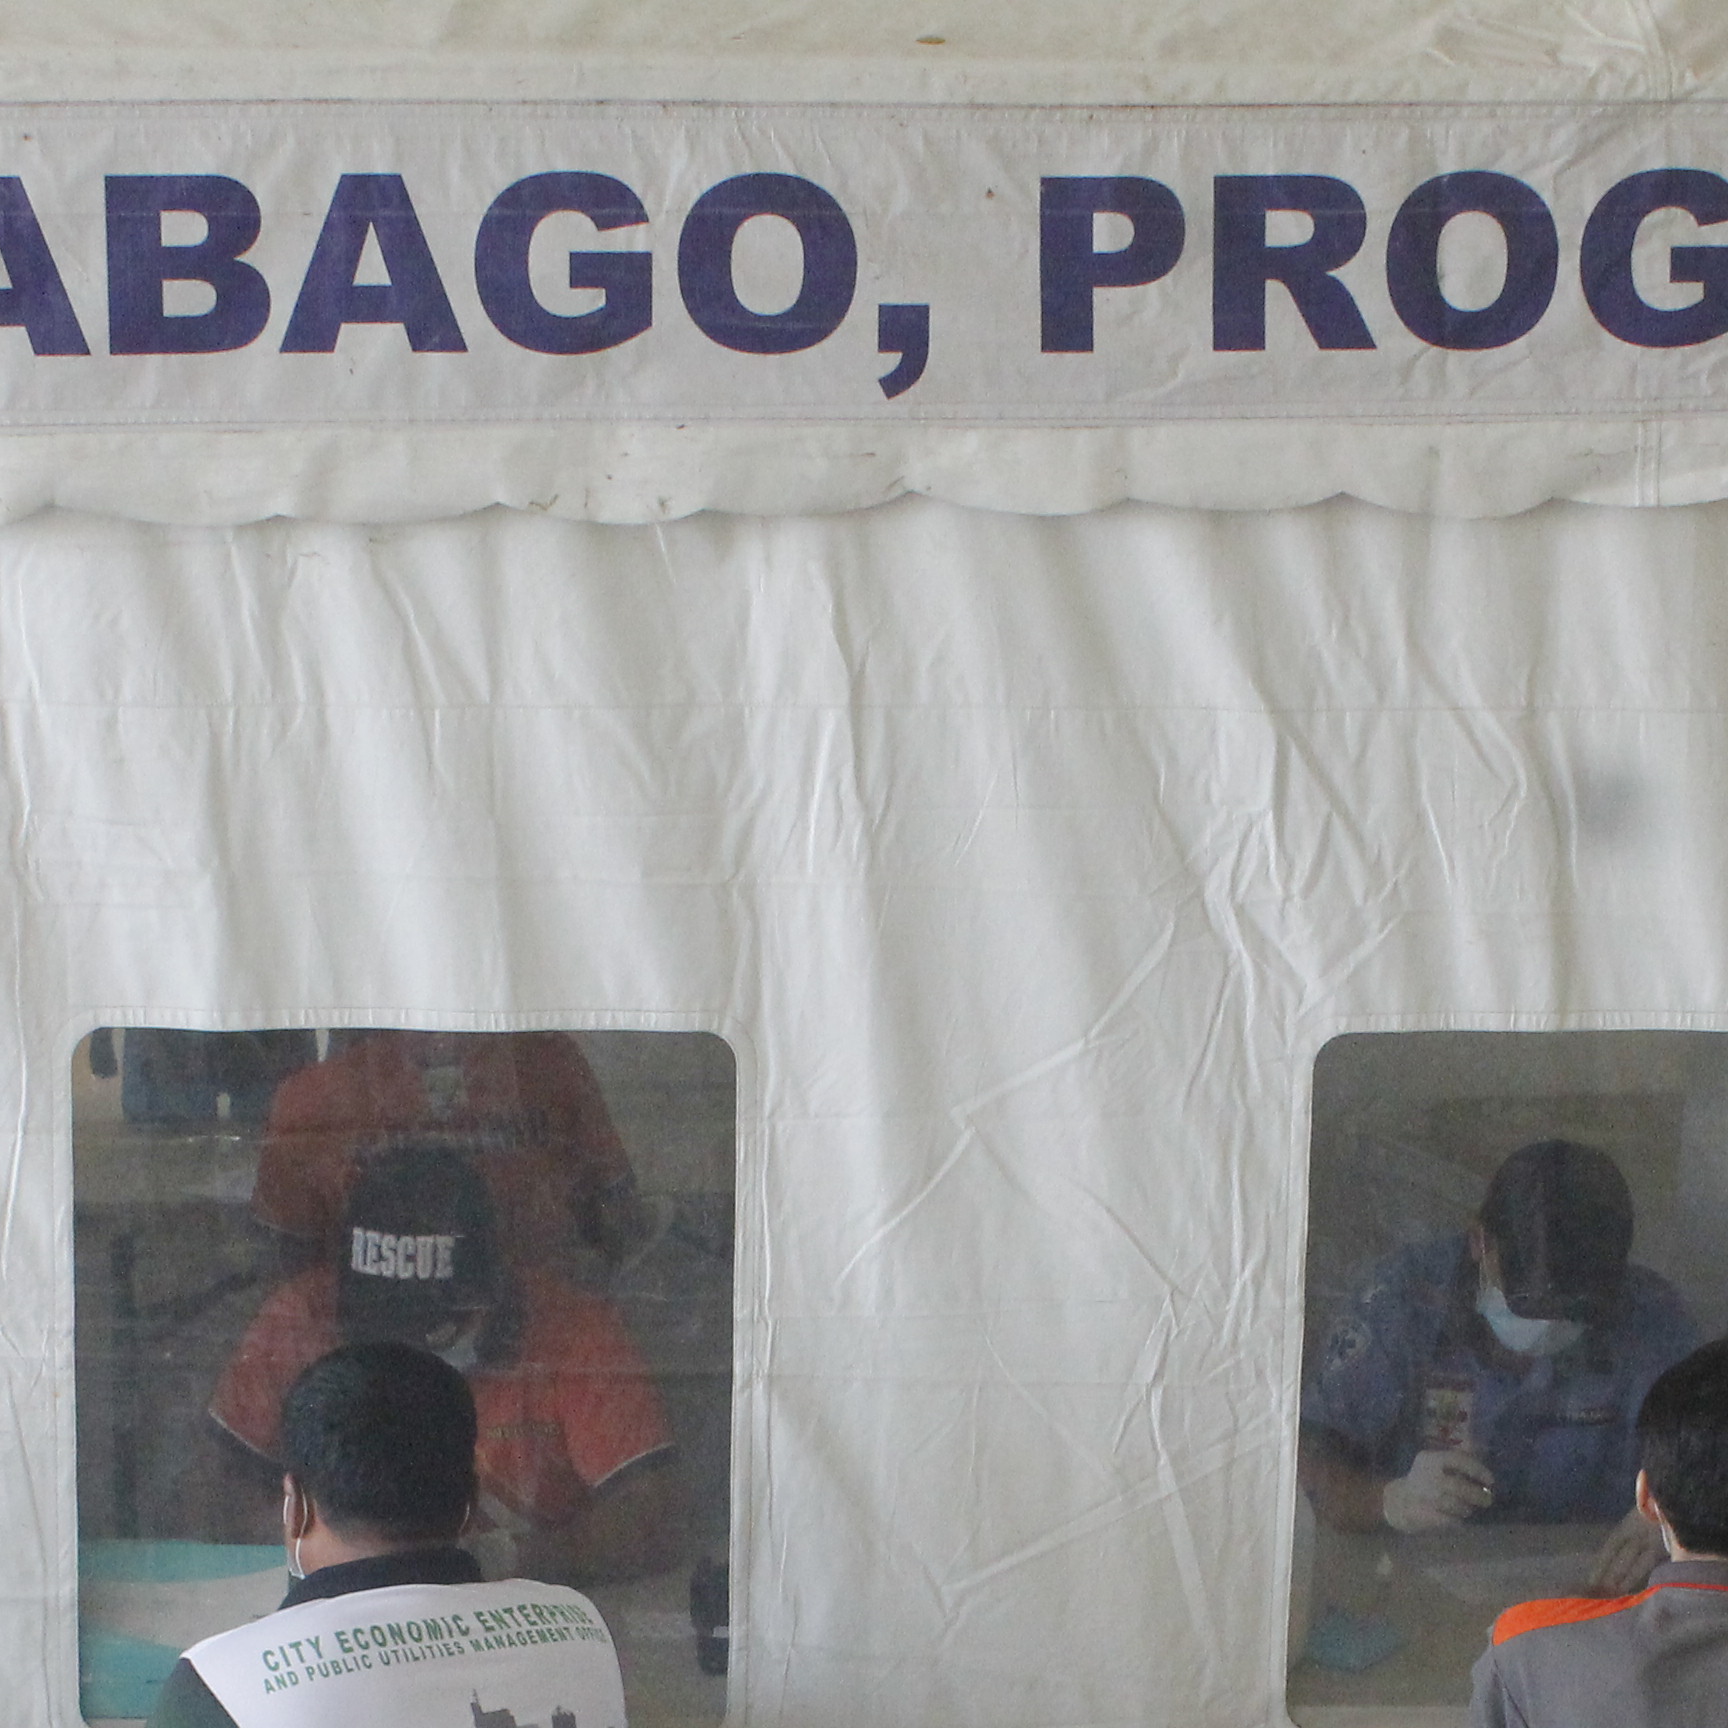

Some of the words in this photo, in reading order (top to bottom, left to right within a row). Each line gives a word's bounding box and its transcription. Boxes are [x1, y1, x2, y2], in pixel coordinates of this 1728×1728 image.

[352, 1227, 455, 1280] RESCUE
[262, 1636, 323, 1672] CITY
[334, 1613, 470, 1654] ECONOMIC
[473, 1603, 594, 1632] ENTERPRISE
[263, 1670, 300, 1694] AND
[305, 1654, 372, 1681] PUBLIC
[378, 1641, 465, 1666] UTILITIES
[469, 1627, 574, 1652] MANAGEMENT
